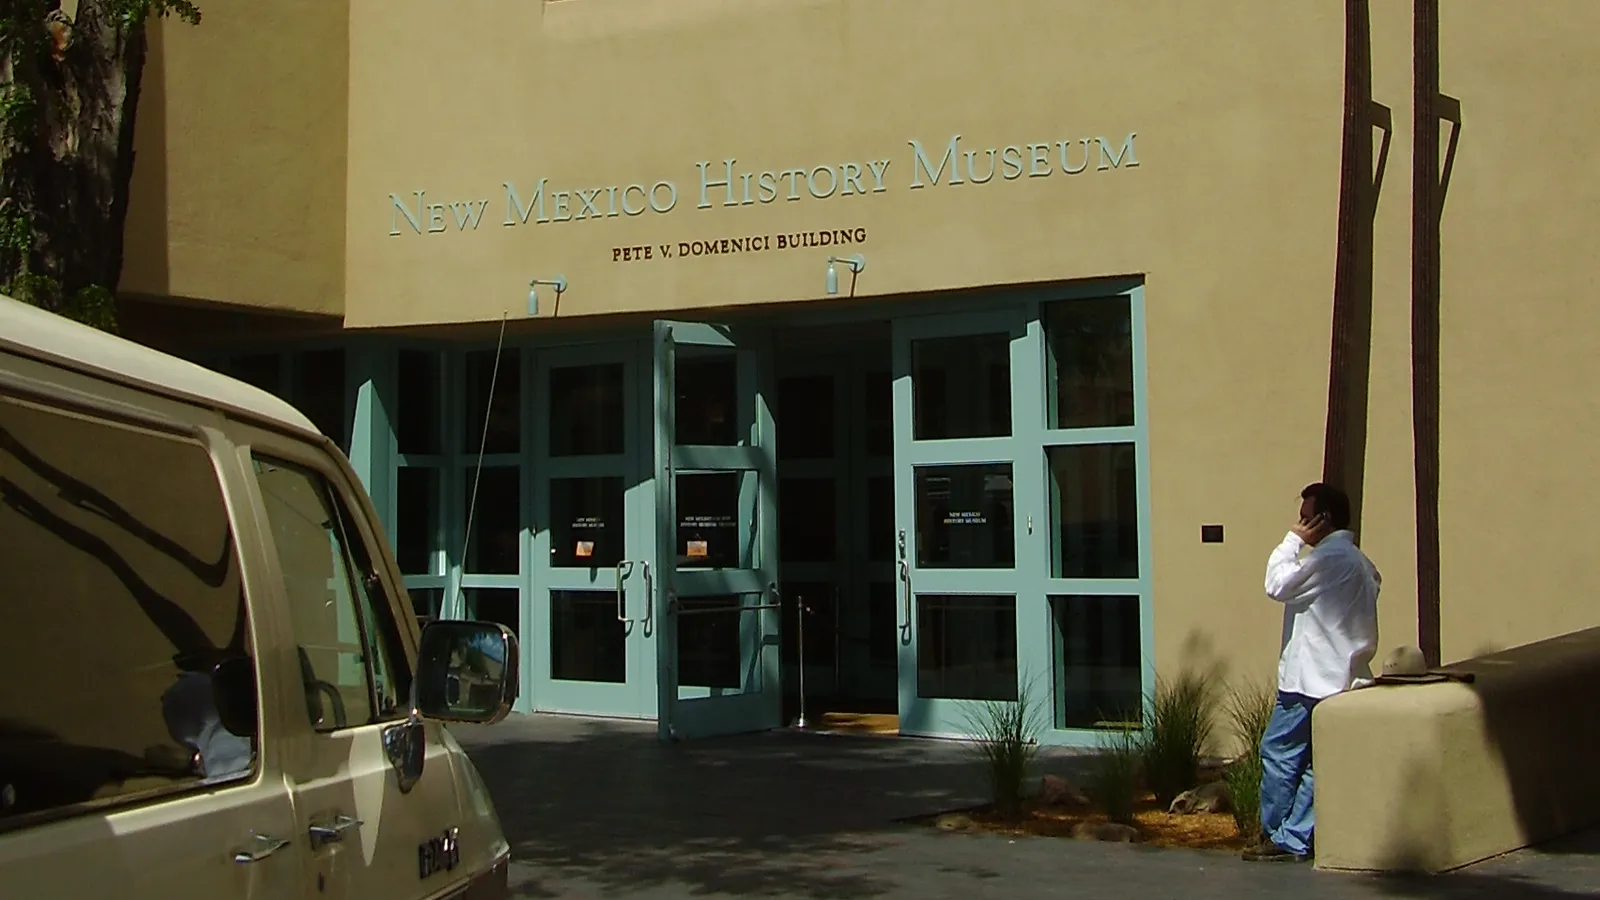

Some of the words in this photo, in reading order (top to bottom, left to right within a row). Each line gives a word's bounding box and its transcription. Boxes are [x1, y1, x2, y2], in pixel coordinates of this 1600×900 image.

[389, 190, 489, 236] NEW
[503, 178, 679, 226] MEXICO
[696, 158, 891, 209] HISTORY
[907, 133, 1140, 190] MUSEUM
[613, 246, 653, 262] PETE
[660, 244, 672, 259] V.
[679, 236, 770, 258] DOMENICI
[777, 228, 867, 250] BUILDING
